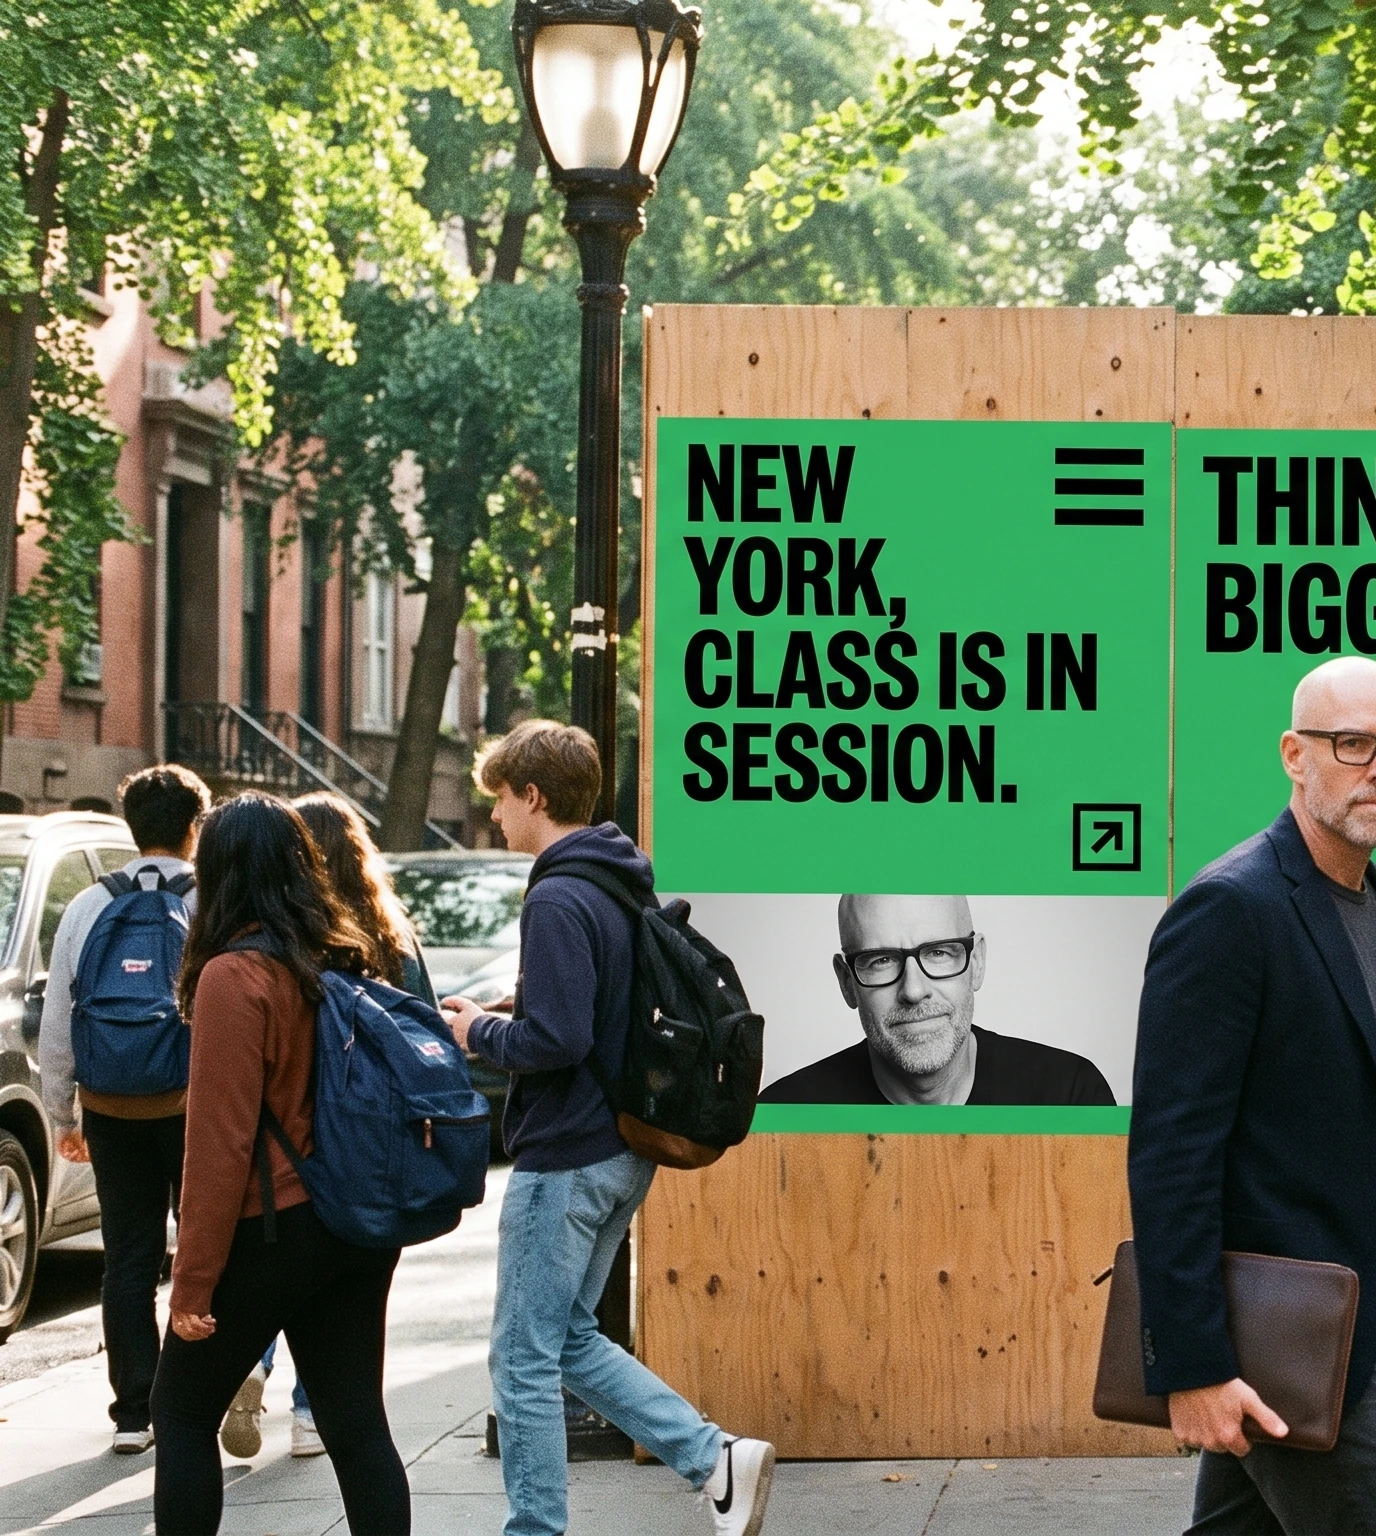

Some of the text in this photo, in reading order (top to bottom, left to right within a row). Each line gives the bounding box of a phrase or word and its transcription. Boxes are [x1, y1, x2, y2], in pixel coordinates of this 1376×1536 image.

[687, 443, 856, 524] NEW
[682, 536, 907, 630] YORK,
[684, 628, 1098, 712] CLASS IS IN
[682, 721, 1018, 804] SESSION.
